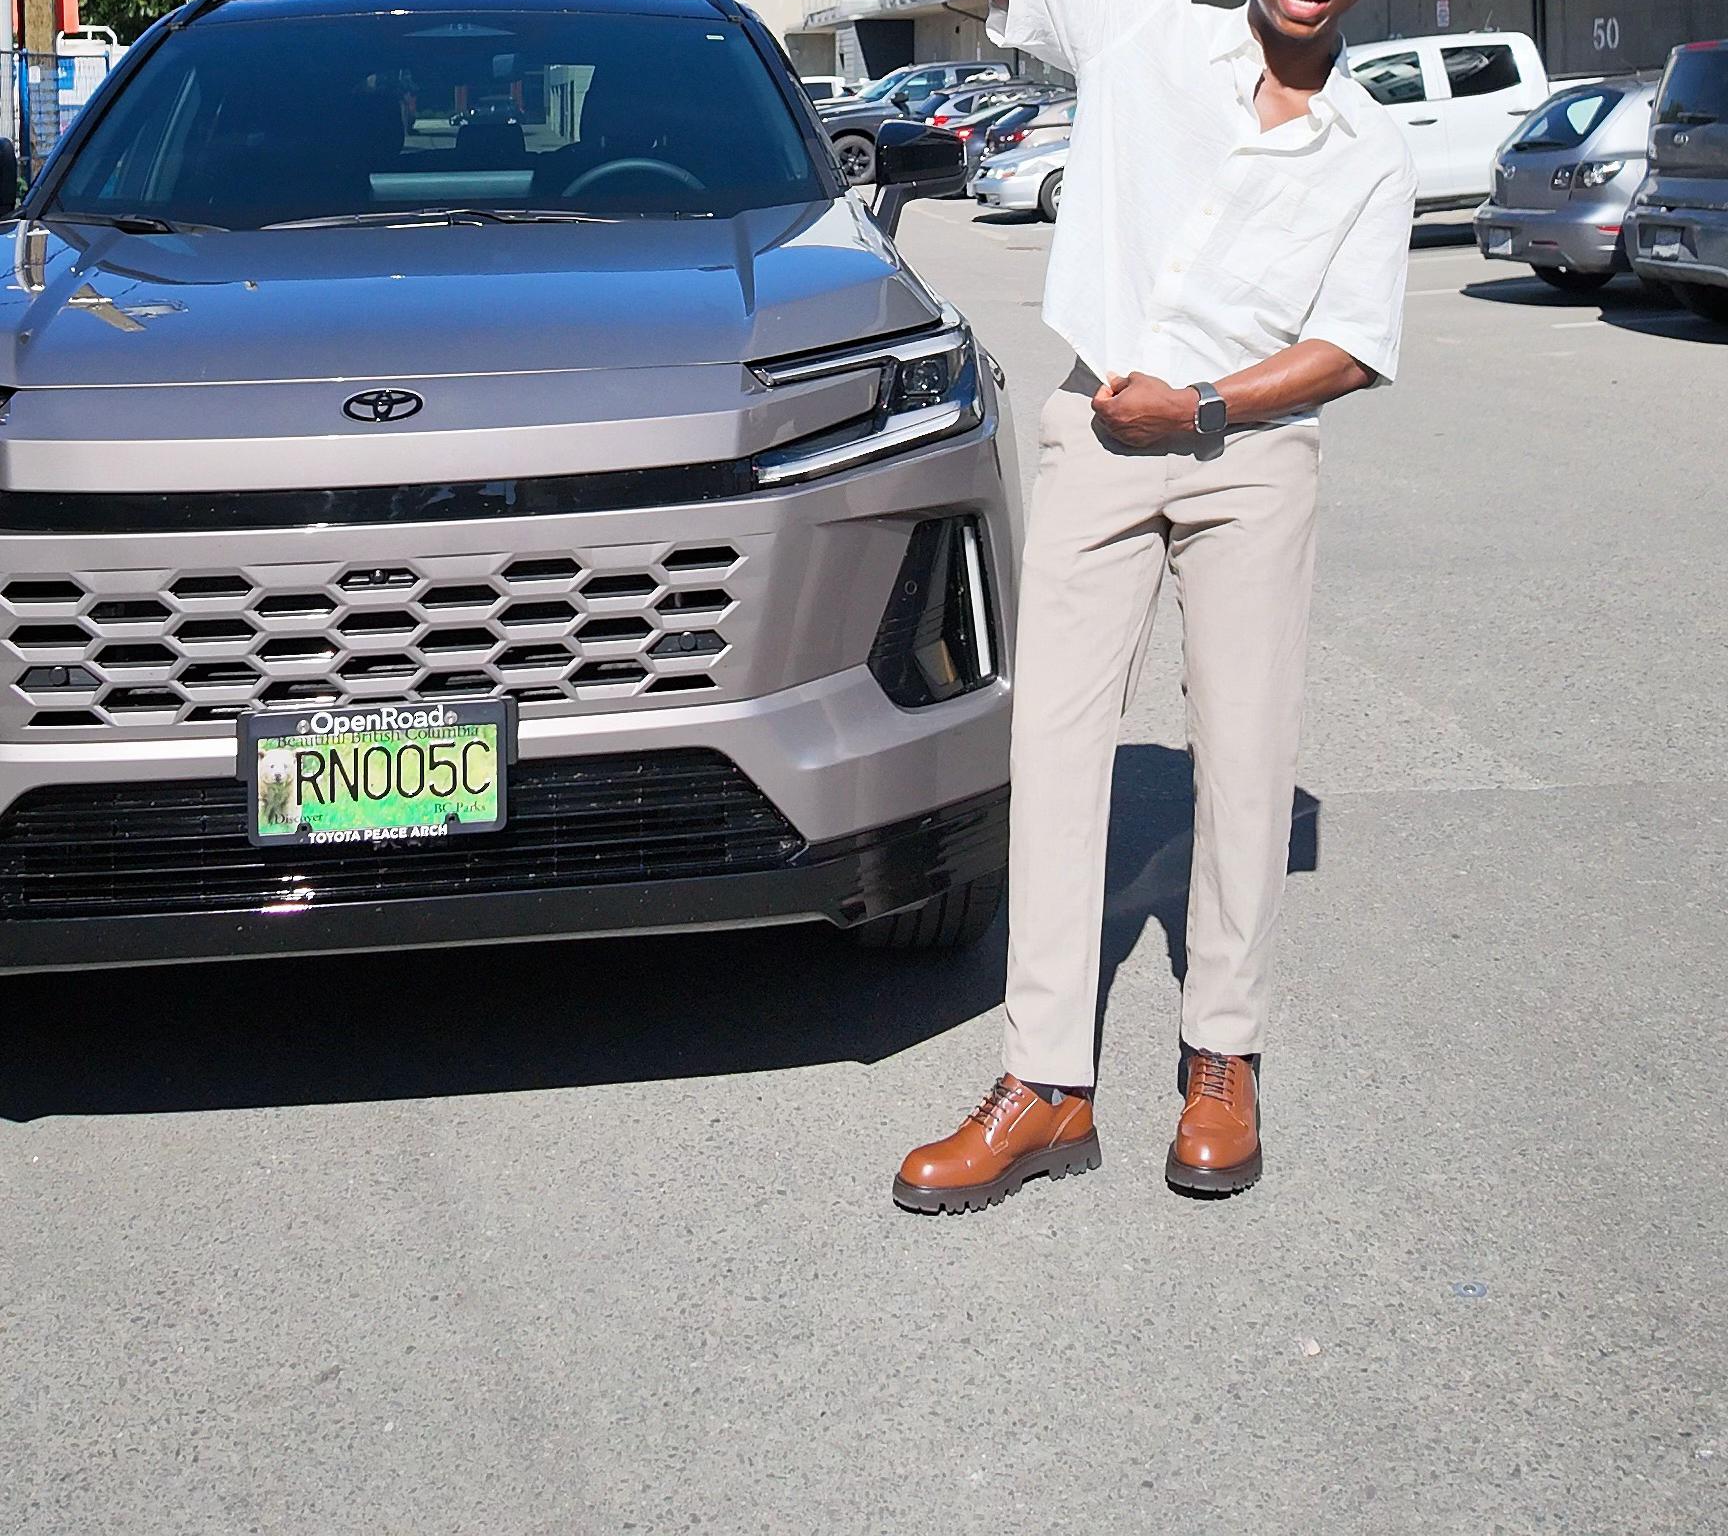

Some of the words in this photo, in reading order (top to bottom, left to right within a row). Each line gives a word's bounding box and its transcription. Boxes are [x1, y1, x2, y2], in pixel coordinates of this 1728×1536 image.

[1593, 16, 1620, 50] 50
[310, 704, 445, 736] OpenRoad
[351, 728, 401, 745] British
[404, 724, 480, 741] Columbia
[295, 739, 491, 806] RN005C
[434, 802, 453, 814] BC
[456, 800, 487, 813] Parks
[275, 813, 324, 825] Discover
[307, 829, 361, 844] TOYOTA
[363, 826, 408, 841] PEACE
[410, 823, 449, 838] ARCH
